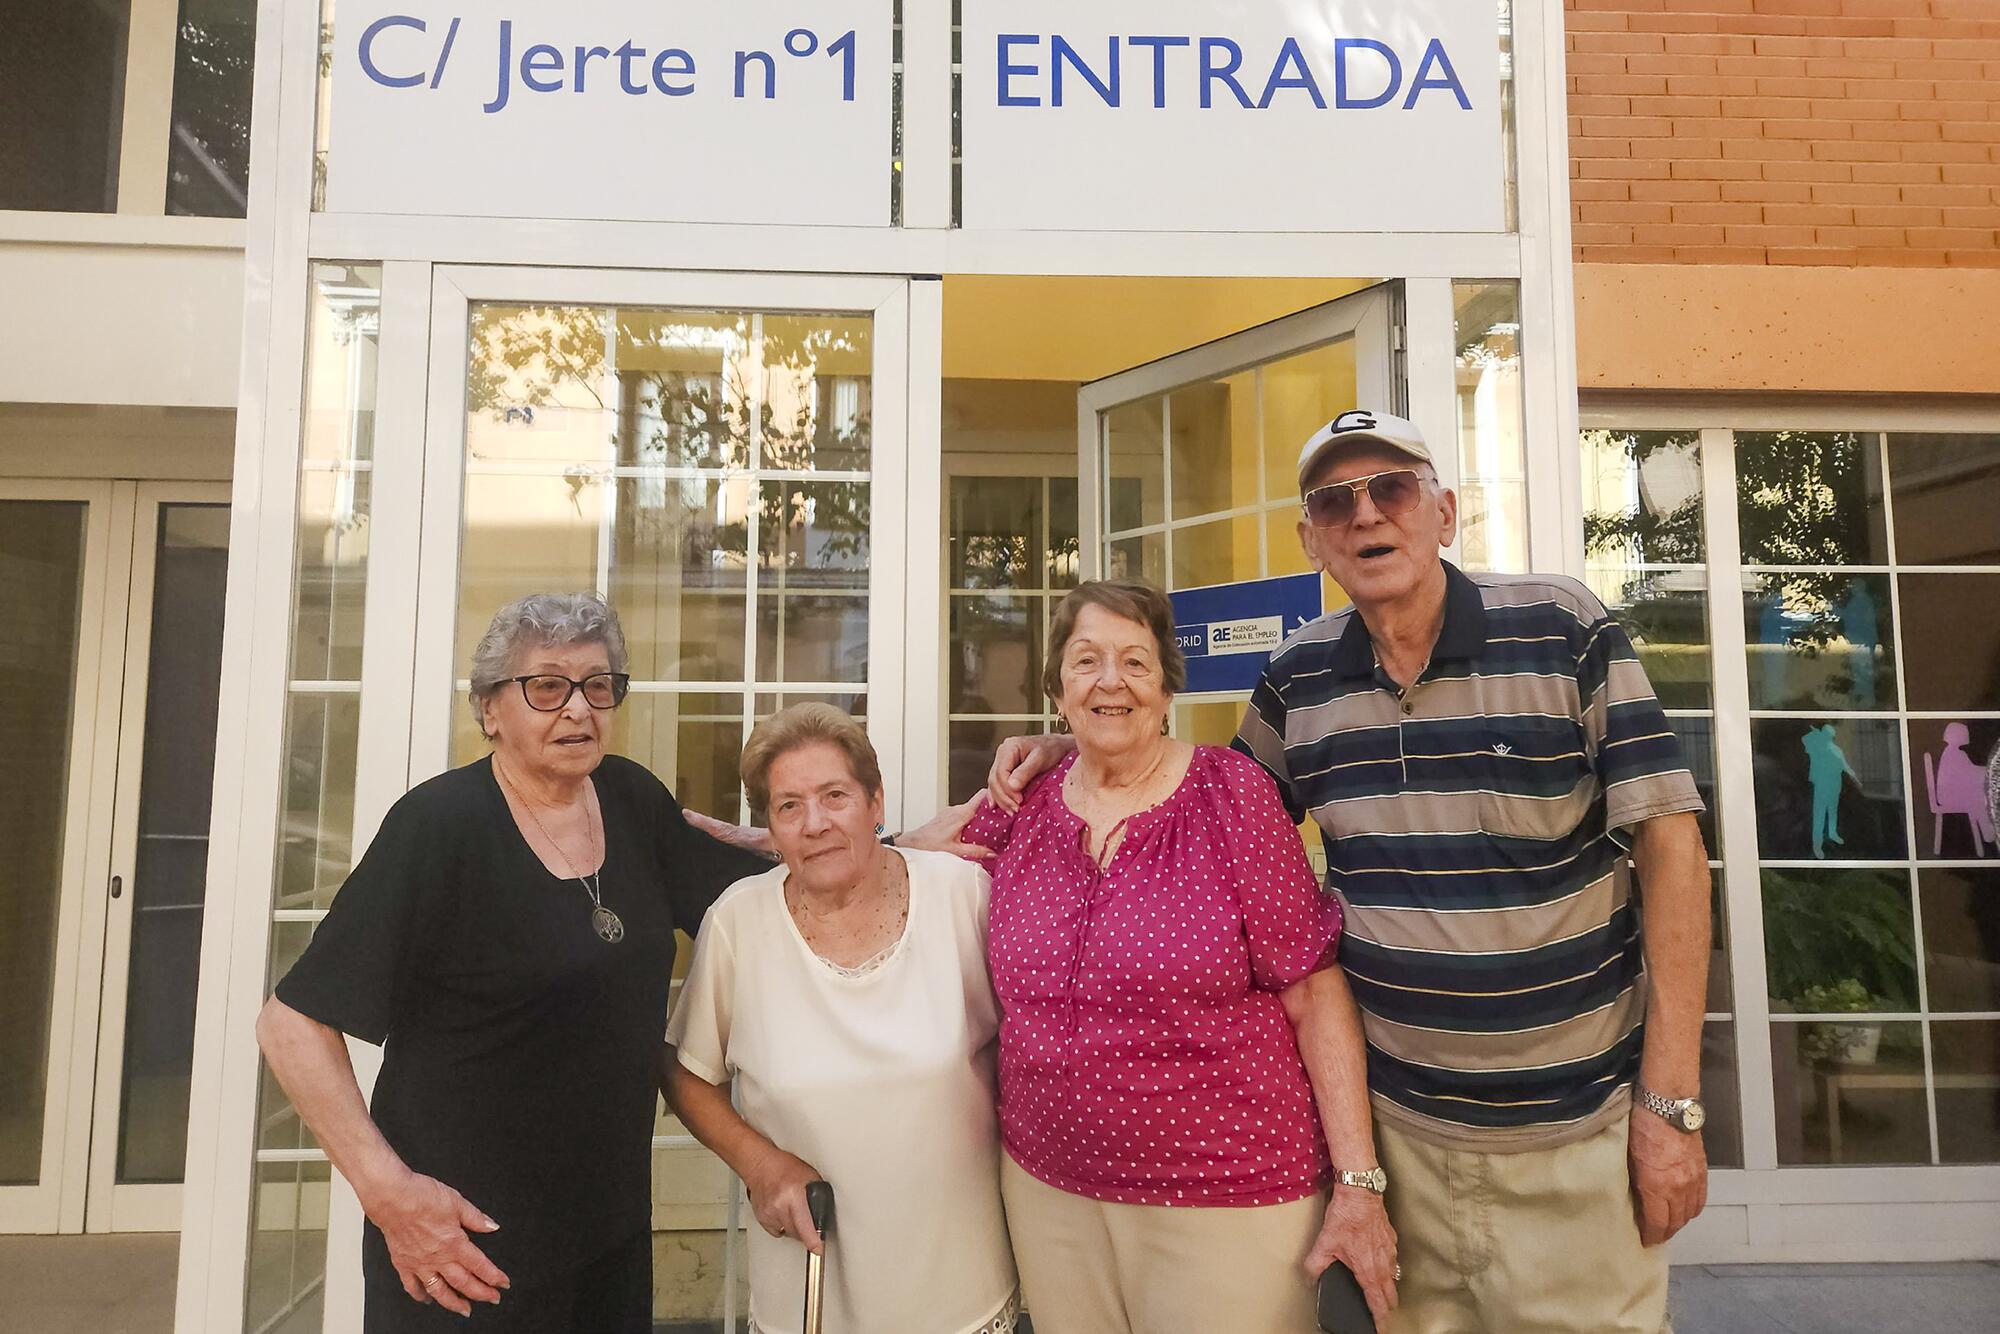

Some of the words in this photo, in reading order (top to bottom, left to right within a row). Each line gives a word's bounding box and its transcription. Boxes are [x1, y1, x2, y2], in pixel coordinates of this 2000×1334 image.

[358, 15, 461, 89] C/
[483, 20, 696, 114] Jerte
[997, 34, 1473, 110] ENTRADA
[1232, 624, 1258, 633] AGENCIA
[1255, 630, 1278, 639] EMPLEO
[1175, 635, 1202, 648] DRID
